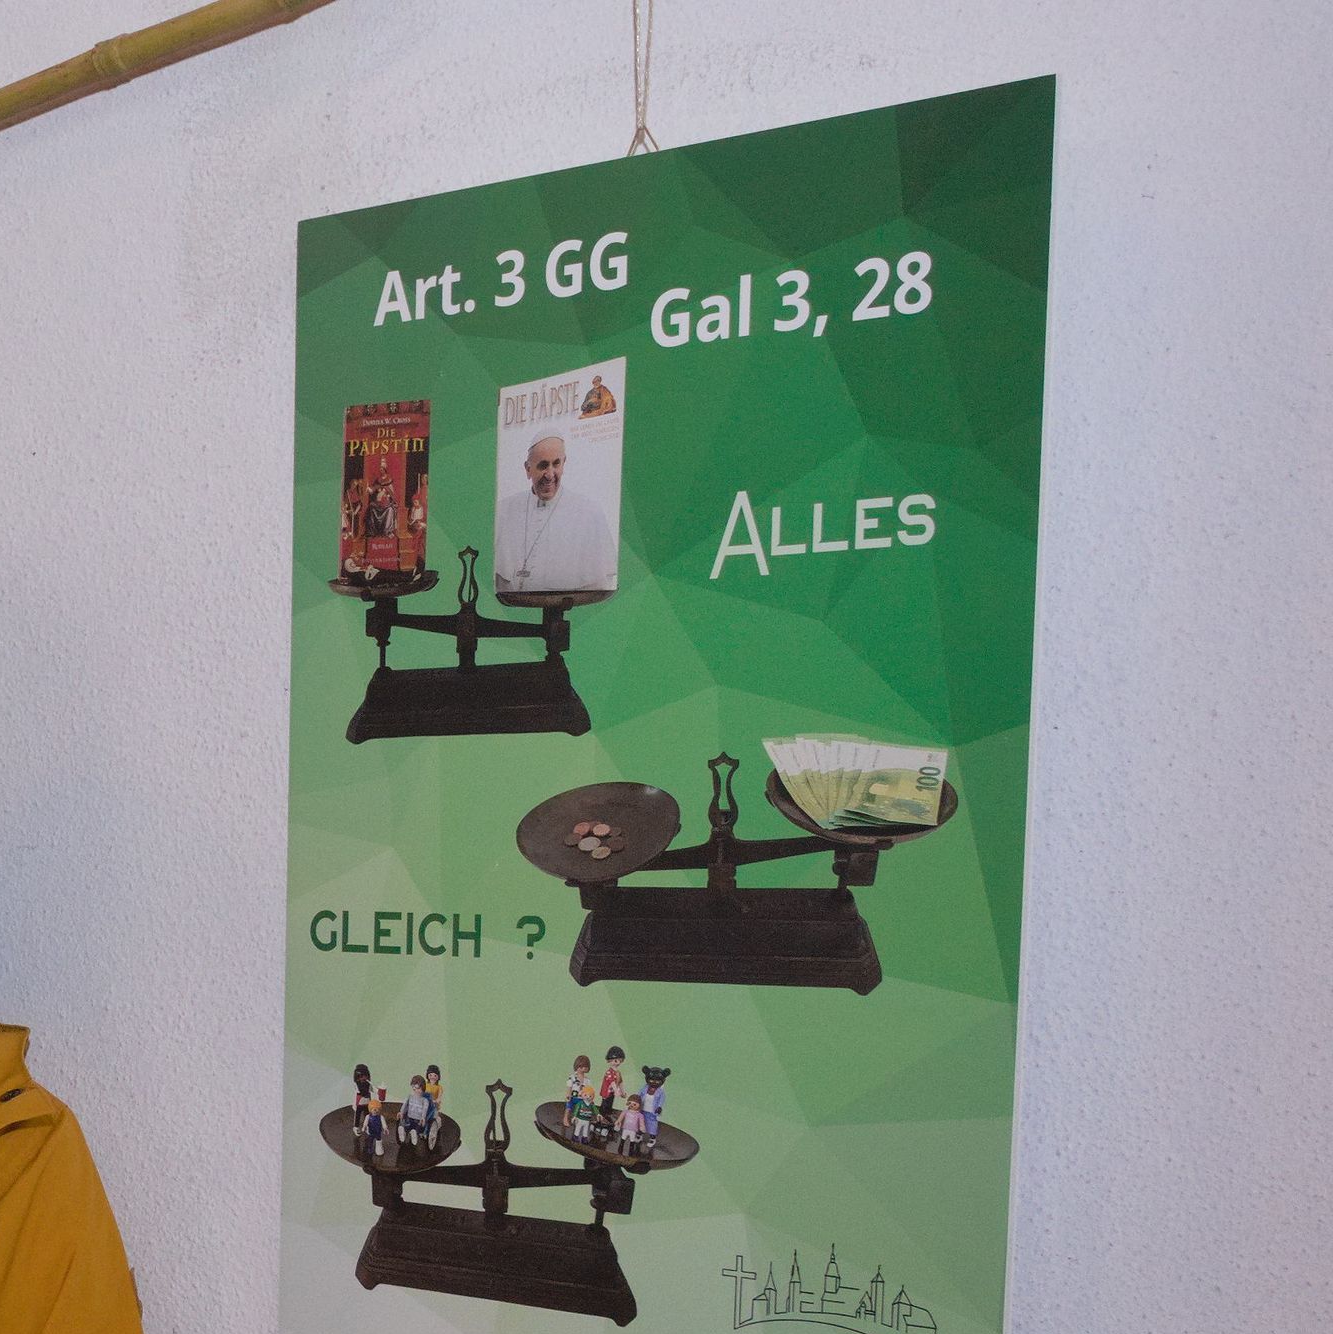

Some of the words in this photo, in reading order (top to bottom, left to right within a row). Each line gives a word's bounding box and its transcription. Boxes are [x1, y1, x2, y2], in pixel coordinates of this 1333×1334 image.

[374, 264, 477, 327] Art.
[494, 249, 527, 308] 3
[545, 231, 629, 299] GG
[650, 273, 752, 348] Gal
[773, 269, 829, 338] 3,
[851, 250, 934, 322] 28
[504, 394, 527, 426] DIE
[530, 381, 580, 421] PÄPSTE
[709, 489, 937, 580] ALLES
[914, 765, 941, 793] 100
[309, 909, 482, 958] GLEICH
[515, 915, 547, 960] ?
